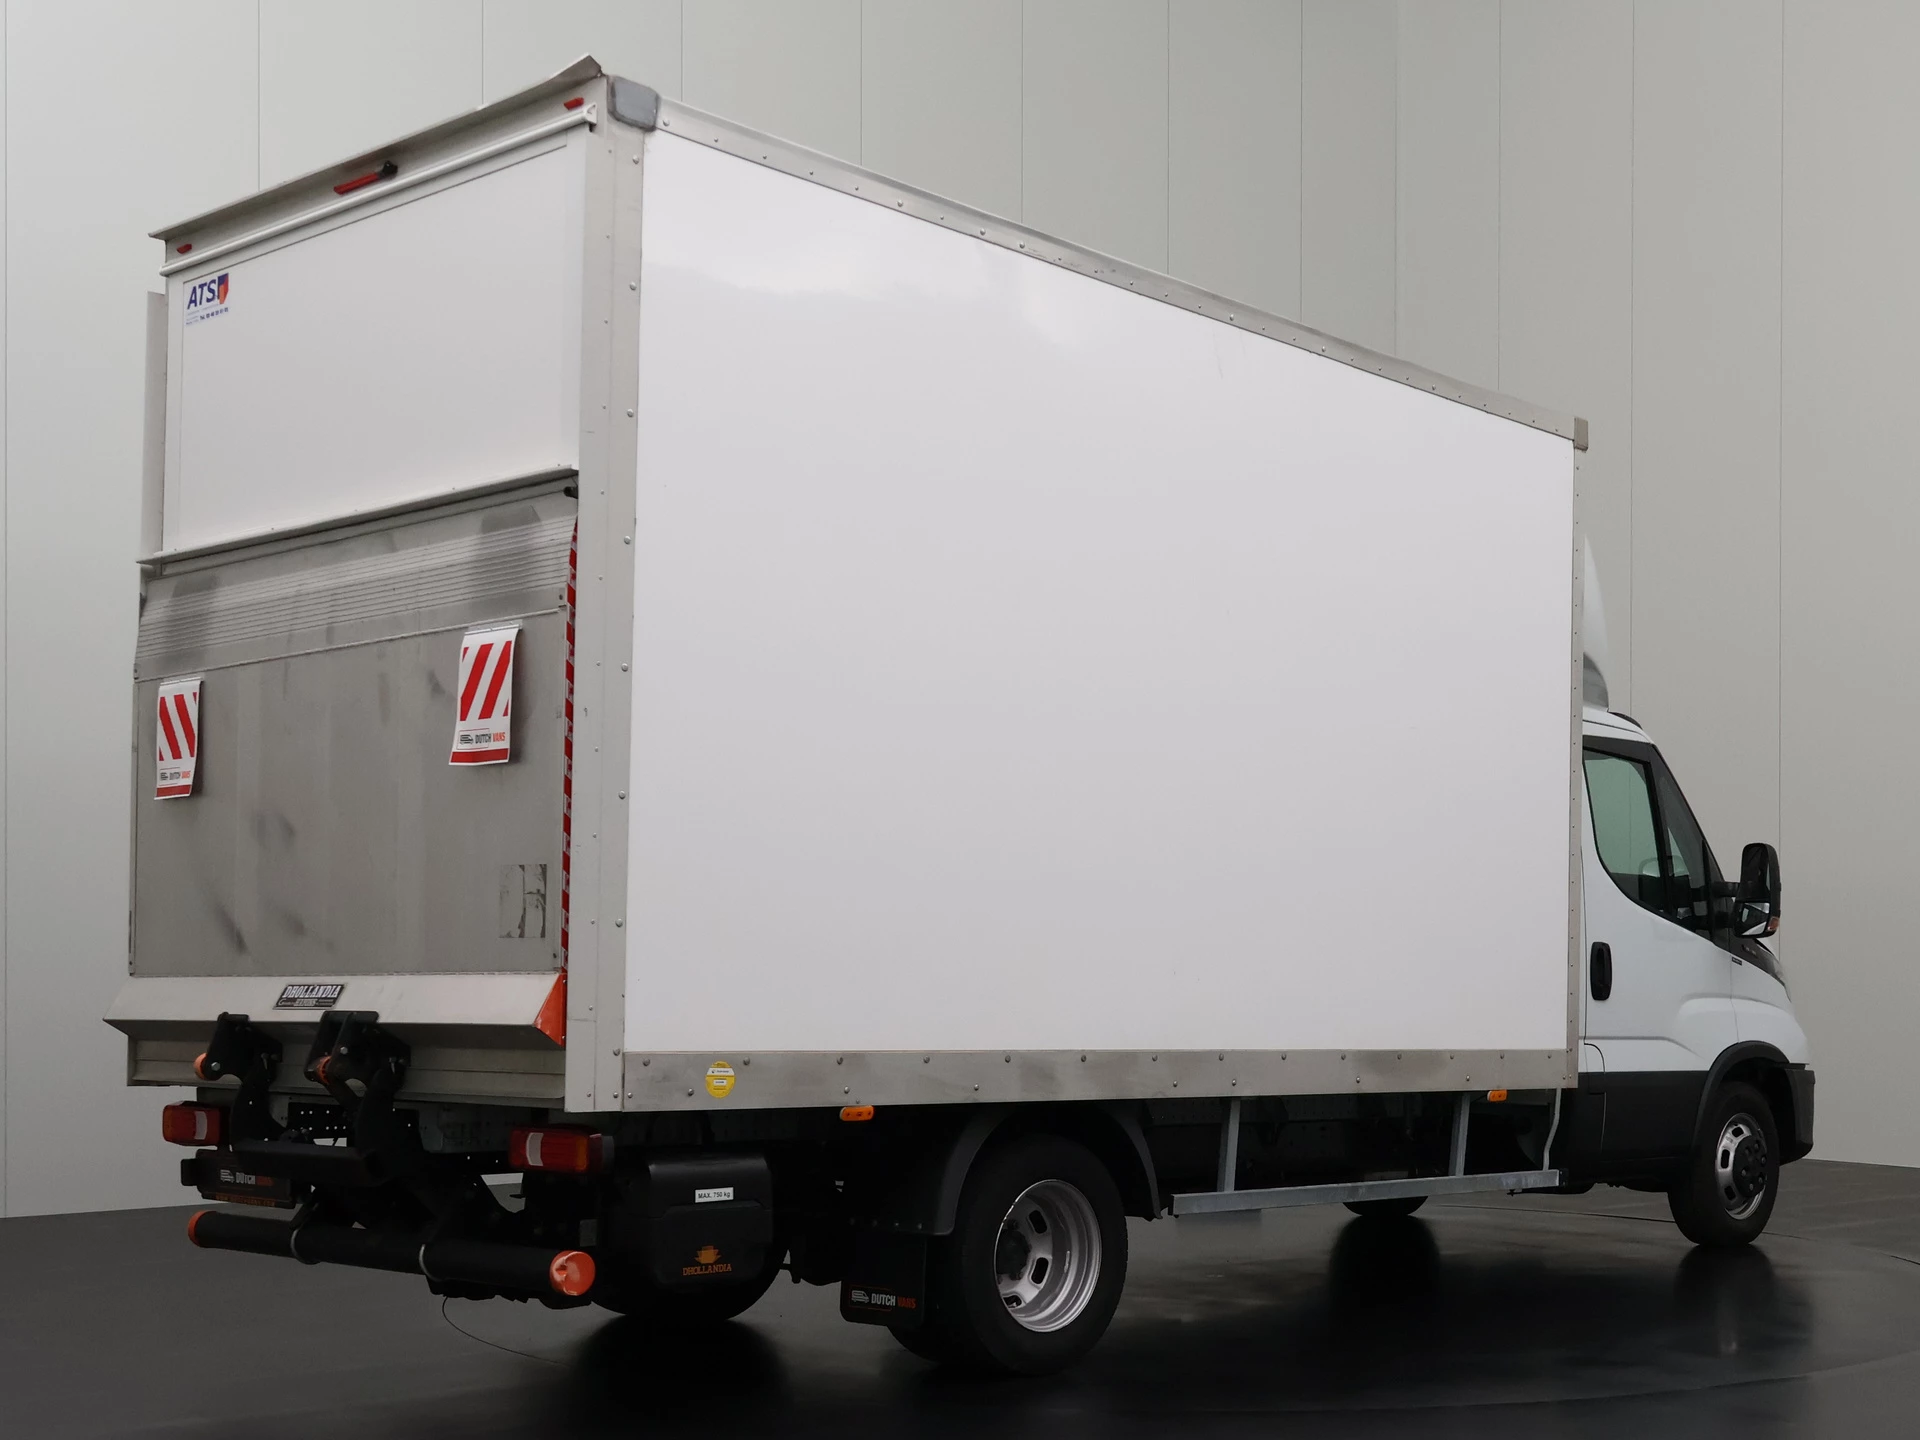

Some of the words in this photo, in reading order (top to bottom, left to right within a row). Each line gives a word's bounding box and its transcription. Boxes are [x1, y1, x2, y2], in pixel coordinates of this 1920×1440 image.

[187, 279, 217, 310] ATS
[475, 733, 491, 744] DUTCH
[492, 732, 505, 742] VANS
[282, 986, 341, 998] DHOLLANDIA
[682, 1263, 732, 1276] DHOLLANDIA
[871, 1293, 896, 1306] DUTCH
[897, 1296, 917, 1309] VANS
